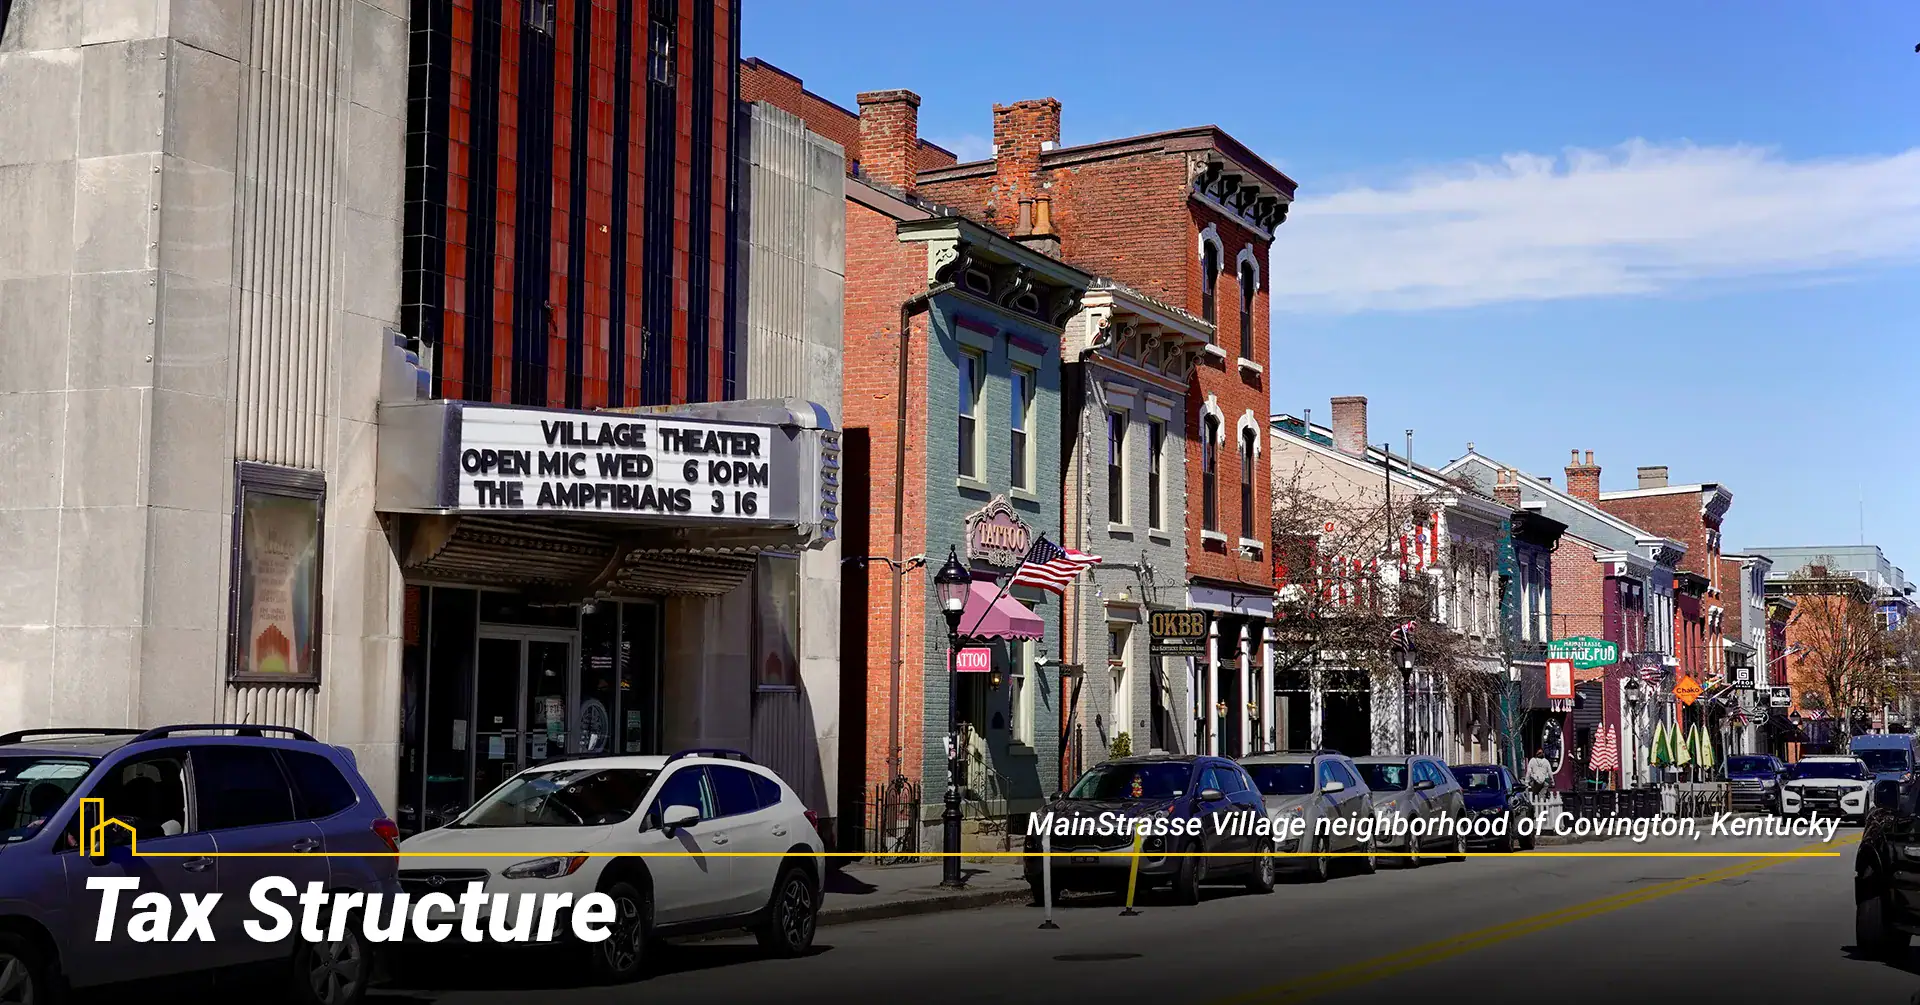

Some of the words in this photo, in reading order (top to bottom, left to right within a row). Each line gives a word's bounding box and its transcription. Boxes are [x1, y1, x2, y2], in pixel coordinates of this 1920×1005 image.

[541, 420, 646, 447] VILLAGE
[659, 428, 760, 456] THEATER
[462, 449, 530, 475] OPEN
[539, 452, 586, 476] MIC
[596, 454, 653, 478] WED
[683, 459, 698, 483] 6
[474, 480, 523, 507] THE
[537, 482, 691, 512] AMPFIBIANS
[711, 490, 724, 513] 3
[734, 490, 757, 514] 16
[979, 522, 1025, 550] TATTOO
[1152, 613, 1203, 636] OKBB
[956, 653, 987, 667] ATTOO
[1550, 645, 1593, 661] VILLAGE
[1594, 645, 1615, 661] PUB
